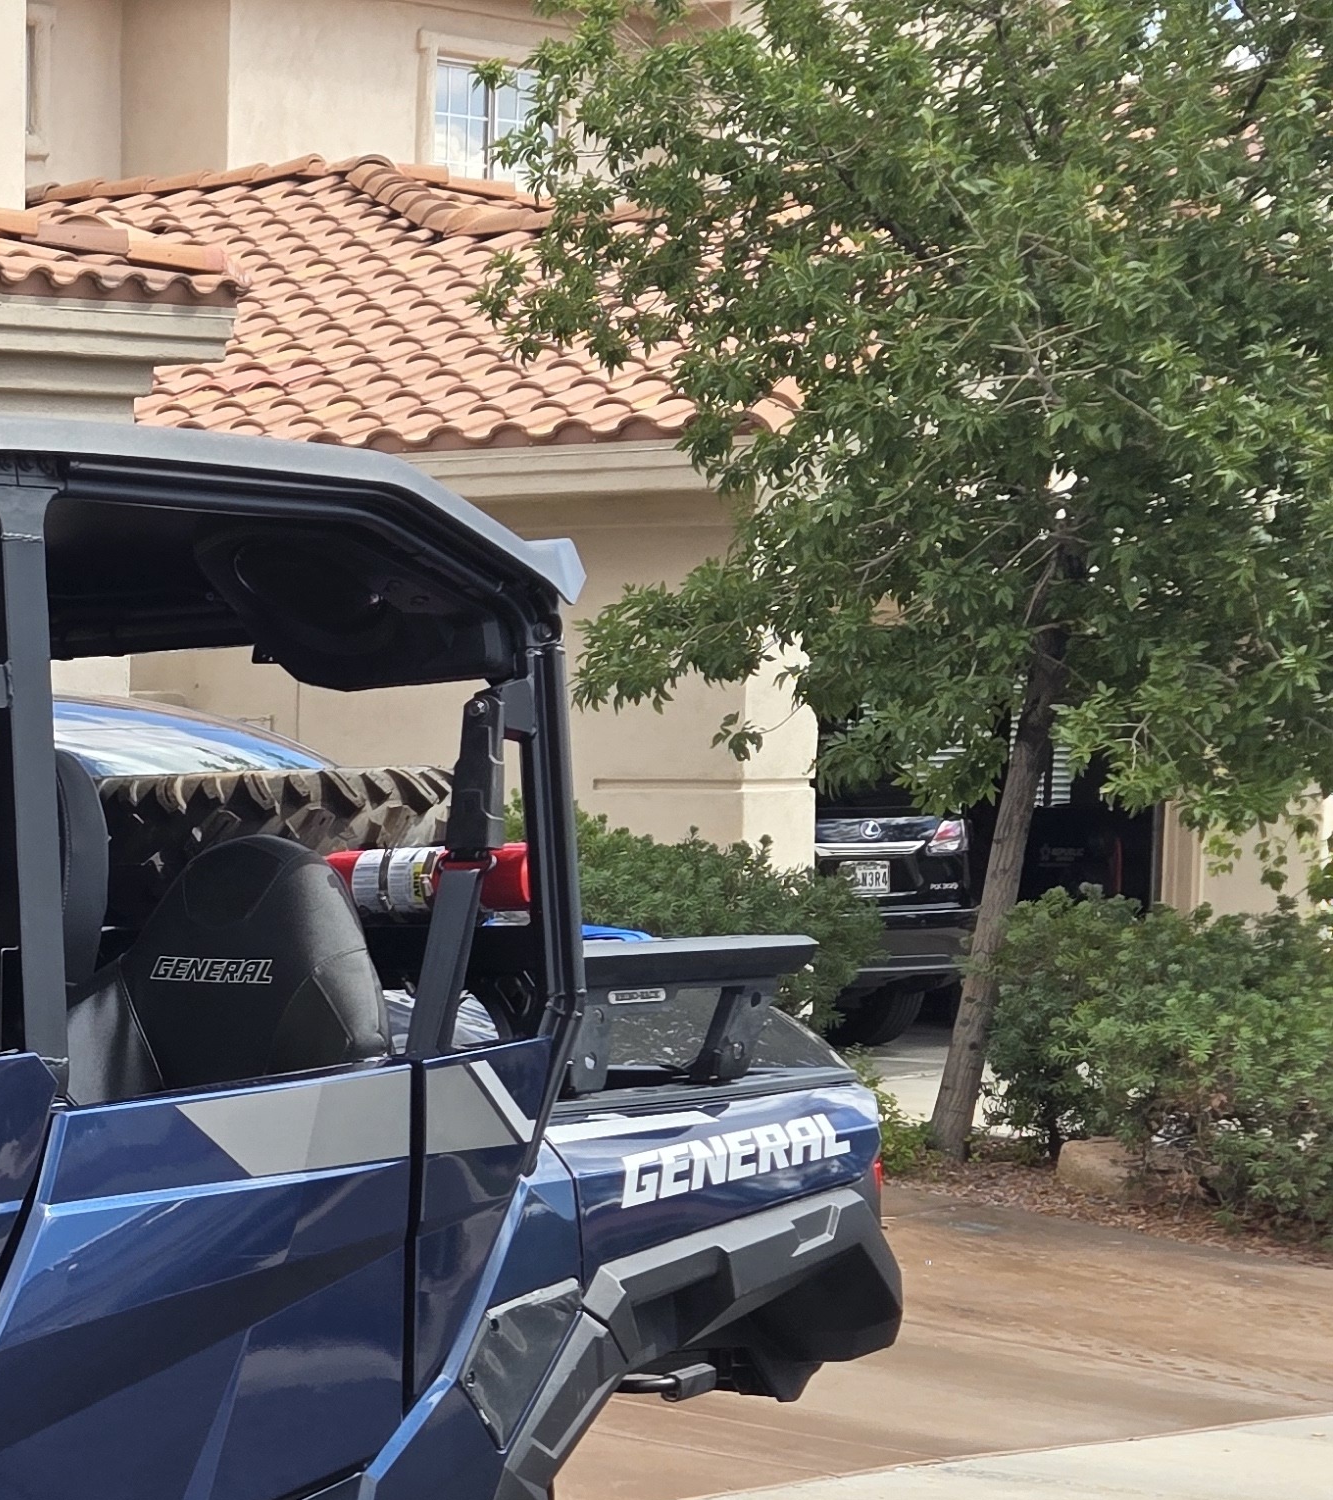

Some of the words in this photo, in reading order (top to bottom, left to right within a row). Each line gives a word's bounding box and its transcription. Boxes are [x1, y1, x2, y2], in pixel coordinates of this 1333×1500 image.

[855, 871, 888, 888] N3R4
[150, 956, 273, 984] GENERAL
[621, 1113, 851, 1209] GENERAL
